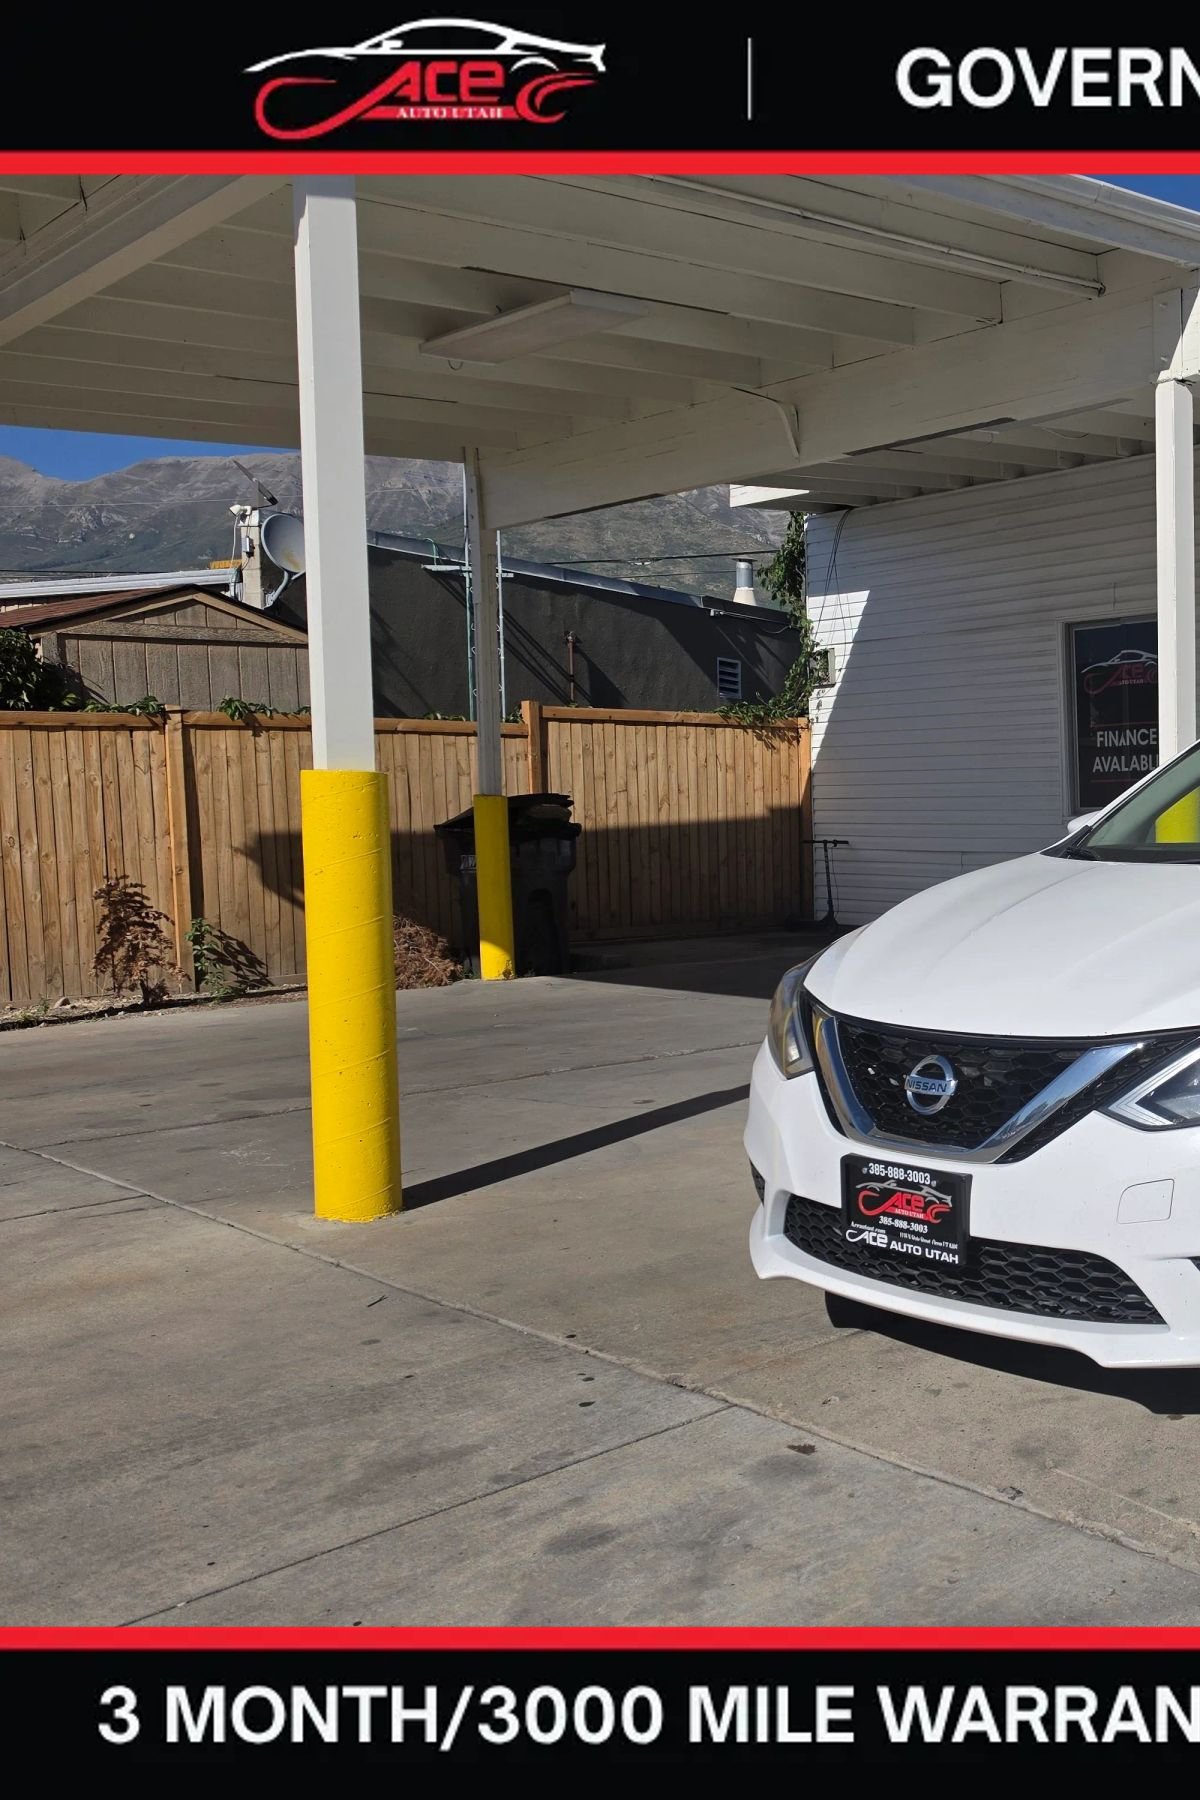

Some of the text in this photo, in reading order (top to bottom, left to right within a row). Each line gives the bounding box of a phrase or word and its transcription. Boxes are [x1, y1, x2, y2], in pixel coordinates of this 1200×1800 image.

[1092, 754, 1160, 773] AVALABL
[907, 1079, 947, 1093] NISSAN
[868, 1162, 931, 1185] 385-888-3003
[878, 1215, 928, 1234] 385-888-3003
[889, 1240, 922, 1256] AUTO
[925, 1248, 959, 1264] UTAH
